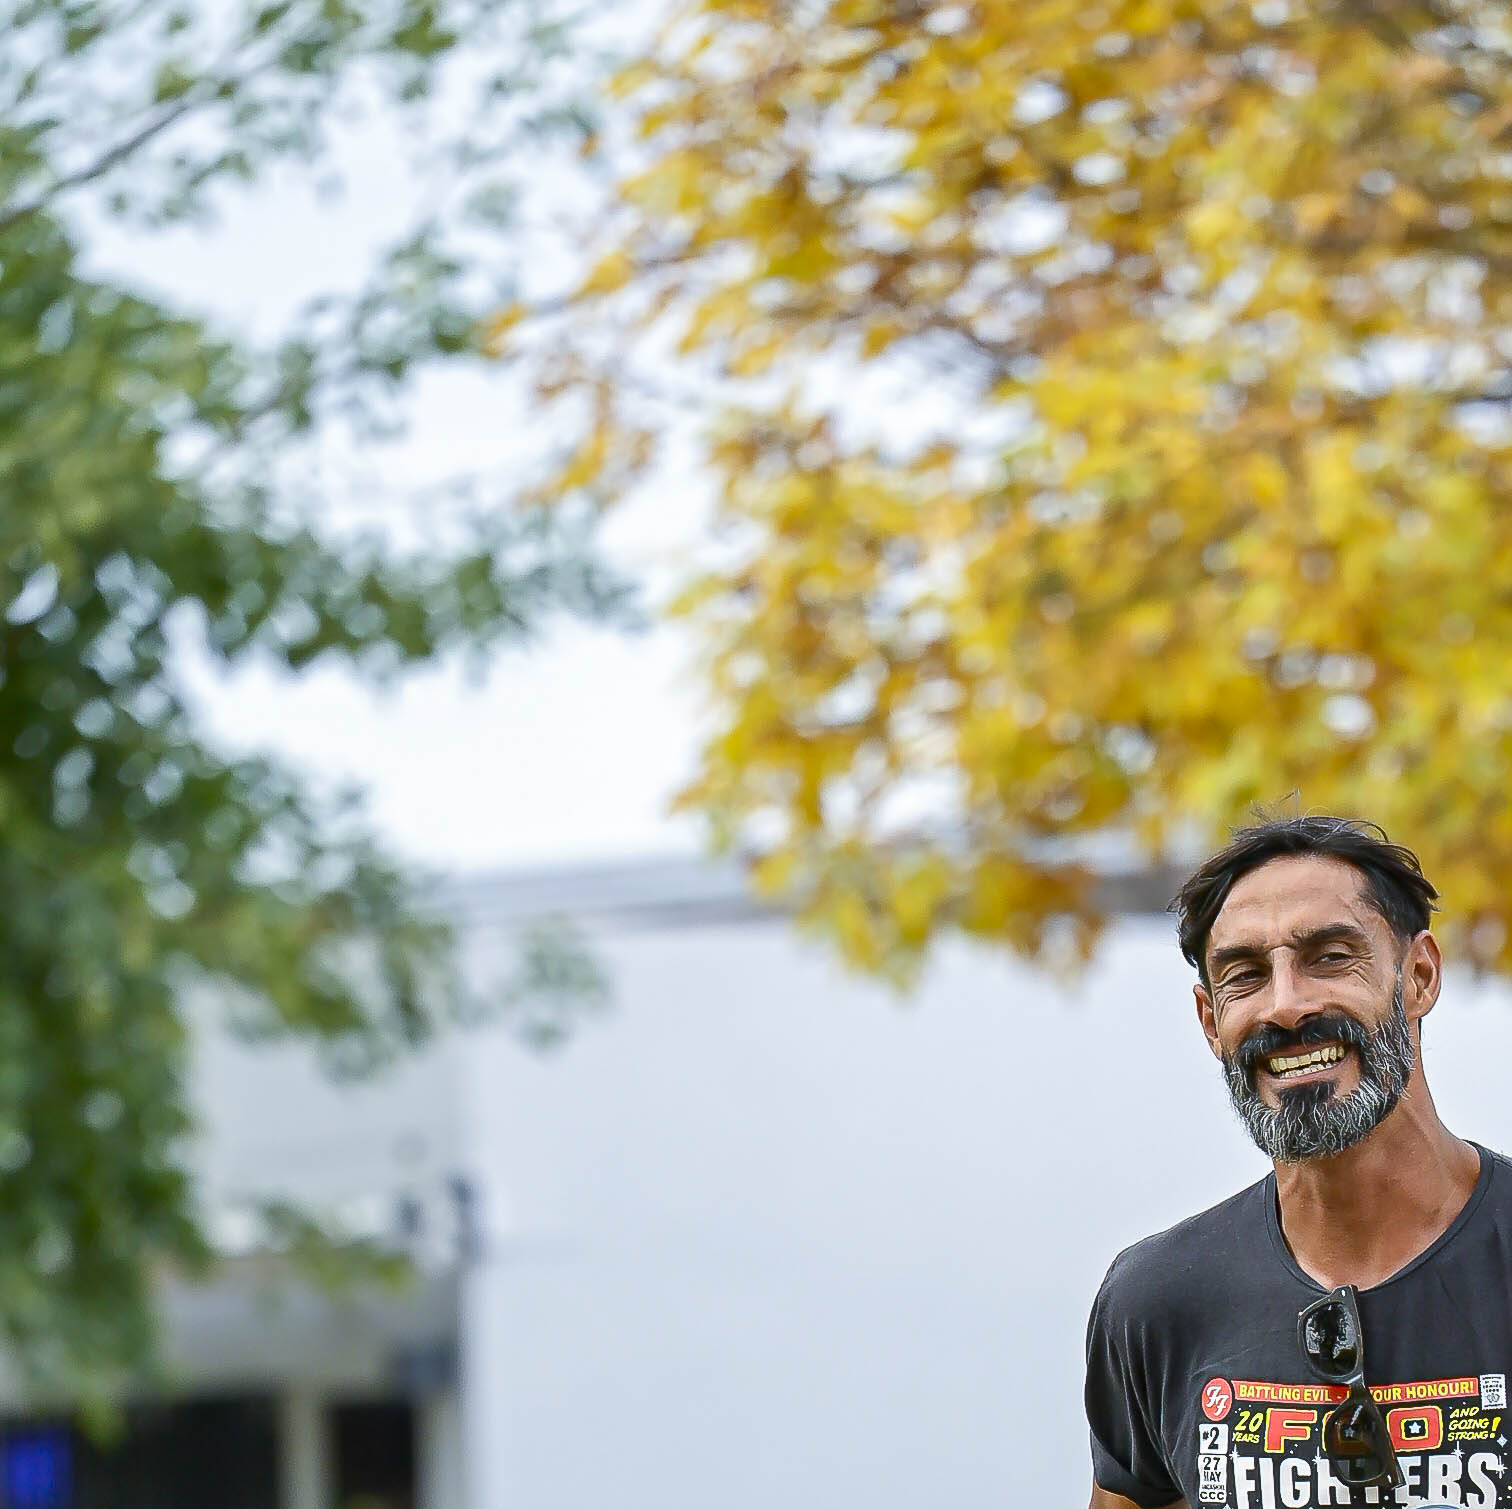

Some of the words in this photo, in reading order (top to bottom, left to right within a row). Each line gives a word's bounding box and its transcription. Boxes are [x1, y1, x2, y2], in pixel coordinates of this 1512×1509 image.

[1239, 1384, 1301, 1400] BATTLING
[1304, 1389, 1333, 1402] EVIL
[1370, 1388, 1402, 1402] OUR
[1406, 1380, 1474, 1399] HONOUR!
[1449, 1406, 1479, 1419] AND
[1234, 1411, 1264, 1432] 20
[1449, 1417, 1490, 1430] GOING
[1202, 1426, 1220, 1450] #2
[1232, 1432, 1260, 1443] YEARS
[1263, 1407, 1444, 1454] FO
[1203, 1456, 1221, 1471] 27
[1200, 1491, 1225, 1500] CCC
